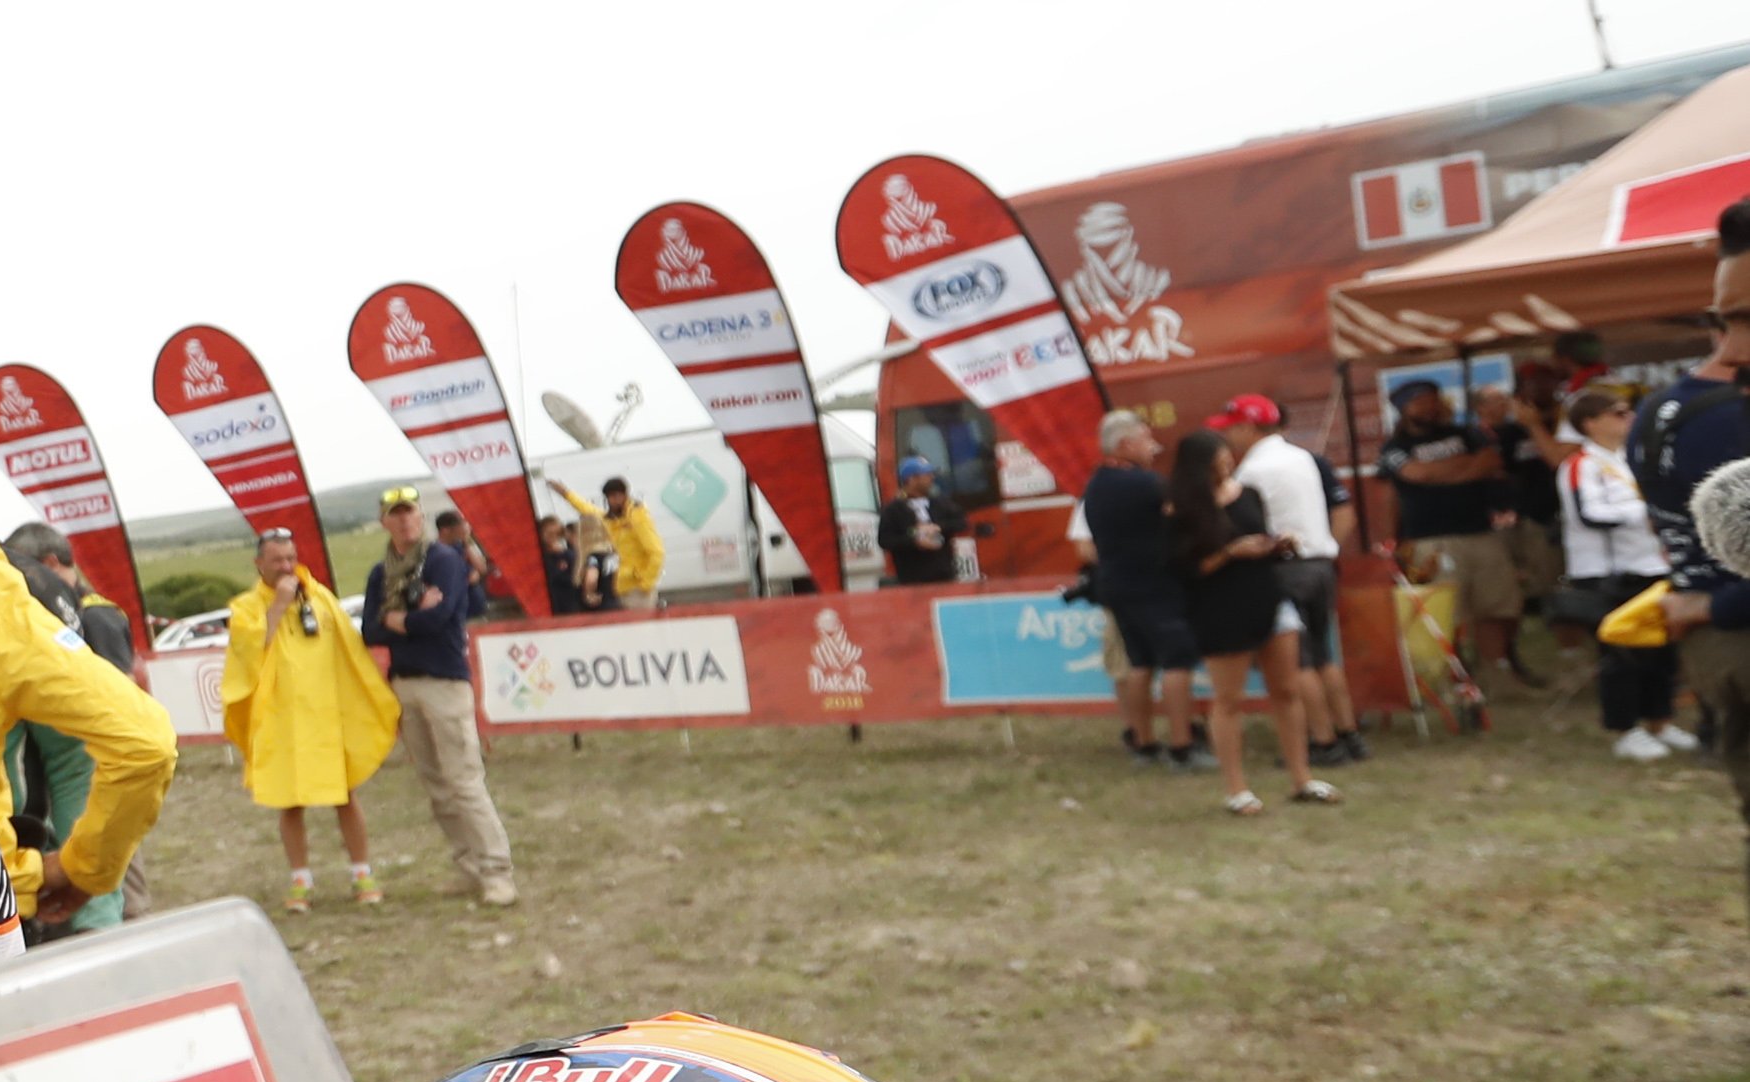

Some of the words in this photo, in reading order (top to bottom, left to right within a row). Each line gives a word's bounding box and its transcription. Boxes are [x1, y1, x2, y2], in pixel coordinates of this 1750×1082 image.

[882, 218, 955, 262] DAKAR
[655, 263, 718, 294] DAKAR
[931, 270, 976, 300] FOX
[659, 314, 754, 342] CADENA
[758, 310, 773, 329] 3
[1086, 305, 1196, 366] AKAR
[383, 334, 436, 365] DAKAR
[183, 374, 229, 401] DAKAR
[710, 389, 803, 410] dakar.com
[193, 413, 277, 447] sodexo
[10, 441, 88, 474] MOTUL
[429, 441, 511, 470] TOYOTA
[49, 496, 108, 521] MOTUL
[1016, 603, 1108, 649] Arge
[565, 649, 729, 692] BOLIVIA
[808, 663, 873, 694] DAKAR
